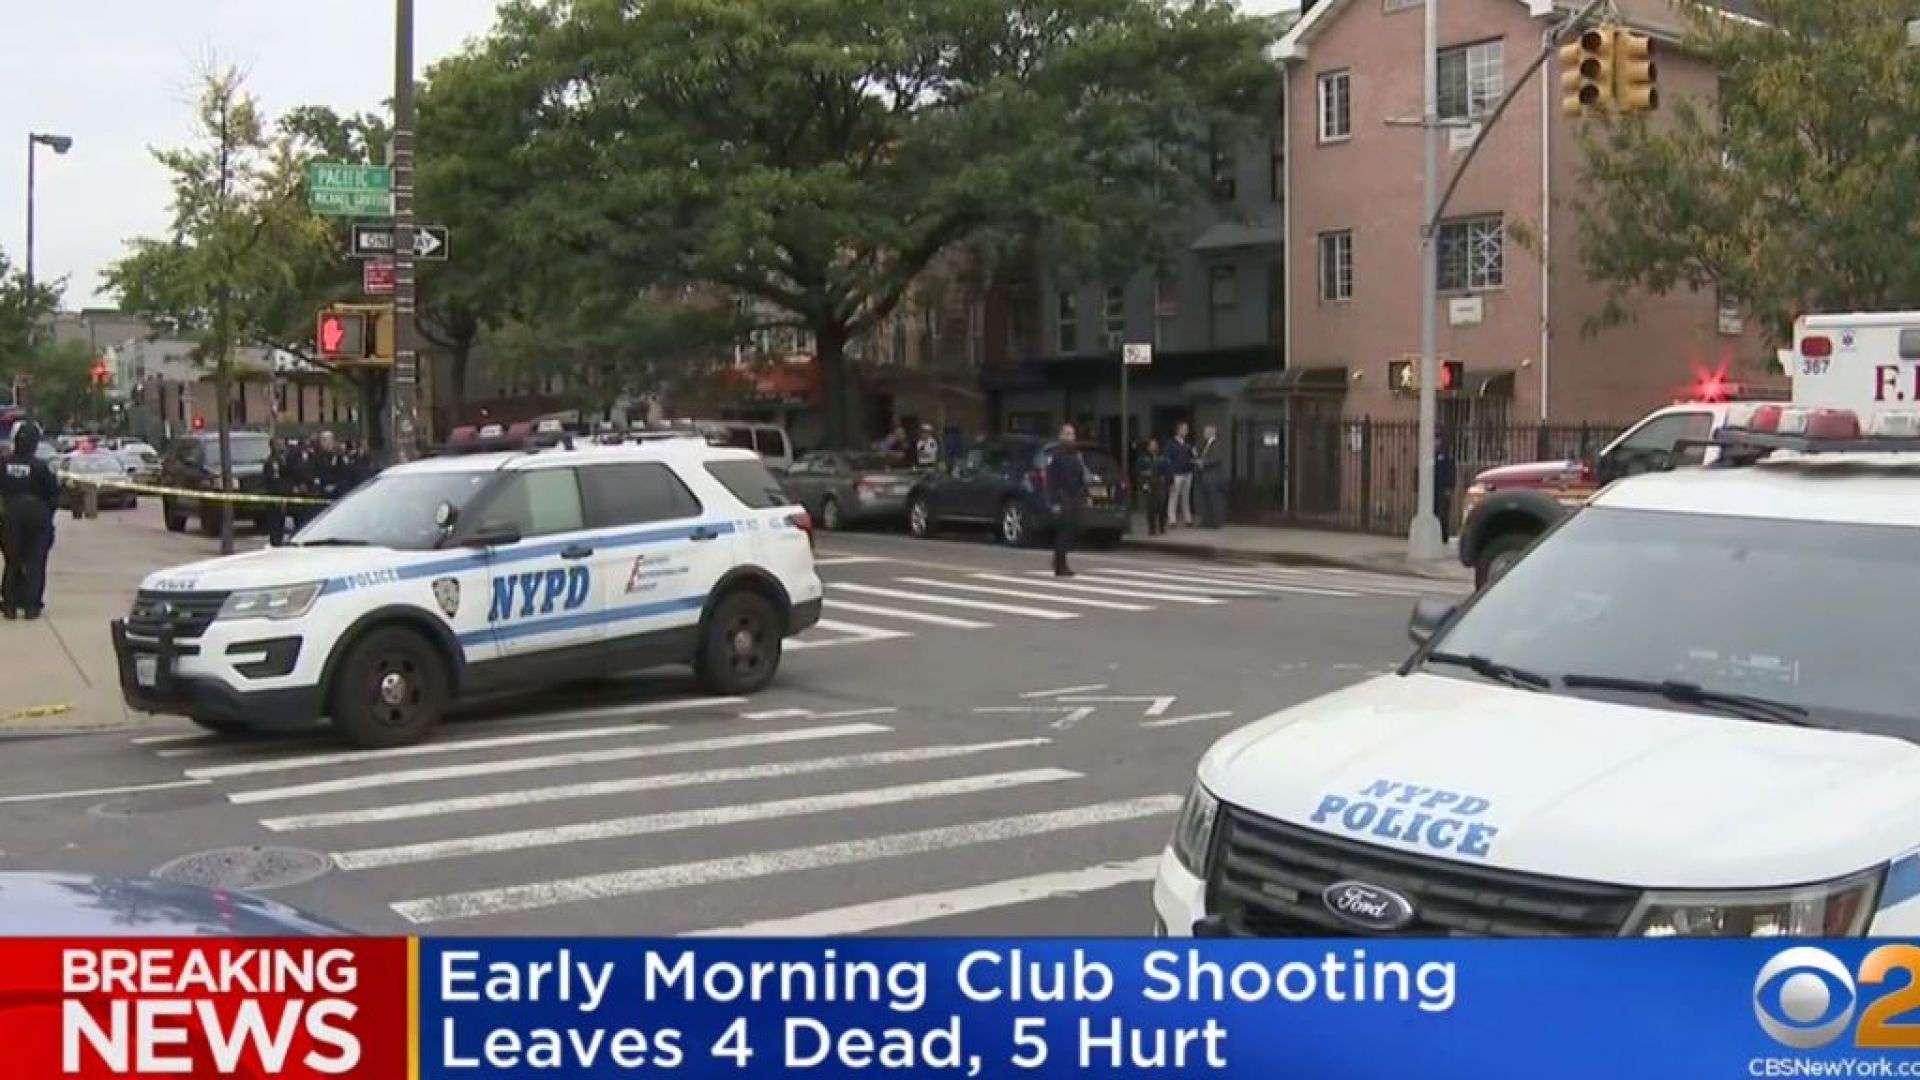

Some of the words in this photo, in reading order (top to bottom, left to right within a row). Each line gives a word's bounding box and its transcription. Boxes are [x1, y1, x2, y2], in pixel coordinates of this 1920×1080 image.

[318, 167, 368, 187] PACIFIC
[347, 566, 399, 589] POLICE
[488, 565, 590, 623] NYPD
[1359, 779, 1490, 816] NYPD
[1310, 794, 1499, 857] POLICE
[1337, 886, 1389, 918] Ford
